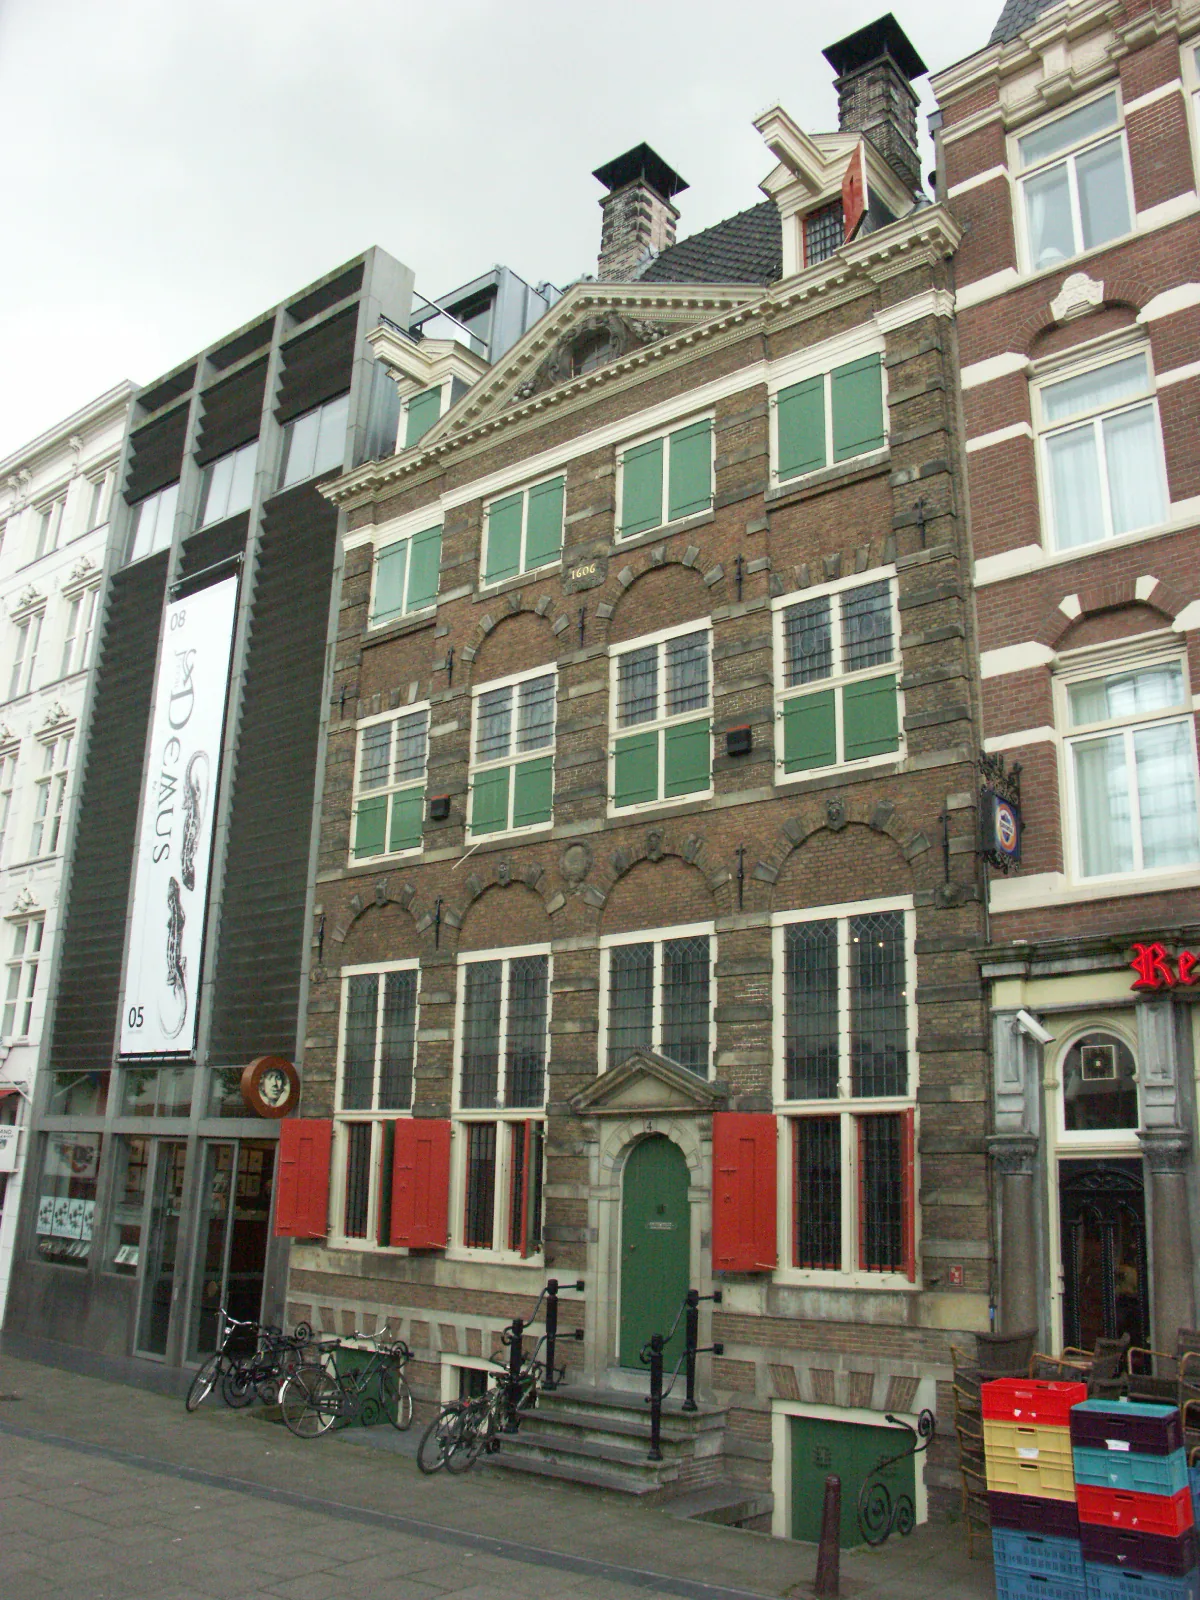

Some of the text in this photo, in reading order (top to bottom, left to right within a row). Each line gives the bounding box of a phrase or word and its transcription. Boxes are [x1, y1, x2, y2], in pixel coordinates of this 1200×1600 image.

[571, 563, 596, 580] 1606
[170, 609, 186, 631] 08
[1130, 942, 1200, 990] Re
[128, 1006, 144, 1028] 05
